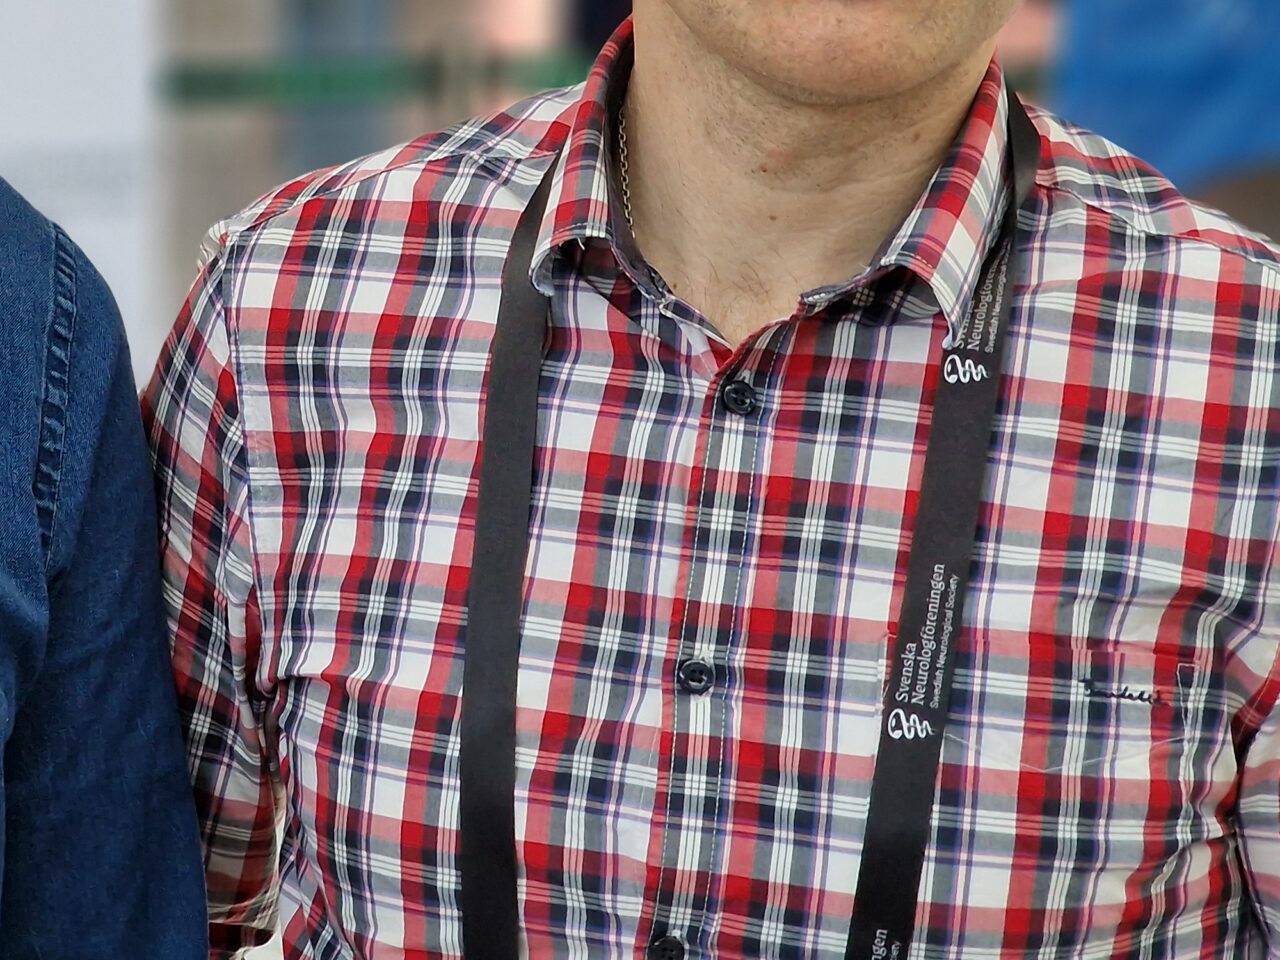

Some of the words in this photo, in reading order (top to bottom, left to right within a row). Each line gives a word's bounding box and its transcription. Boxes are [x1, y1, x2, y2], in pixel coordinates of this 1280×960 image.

[945, 573, 960, 609] Society
[911, 563, 946, 706] Neurologföreningen
[936, 608, 954, 670] Neurological
[895, 642, 918, 702] Svenska
[929, 667, 945, 709] Swedish
